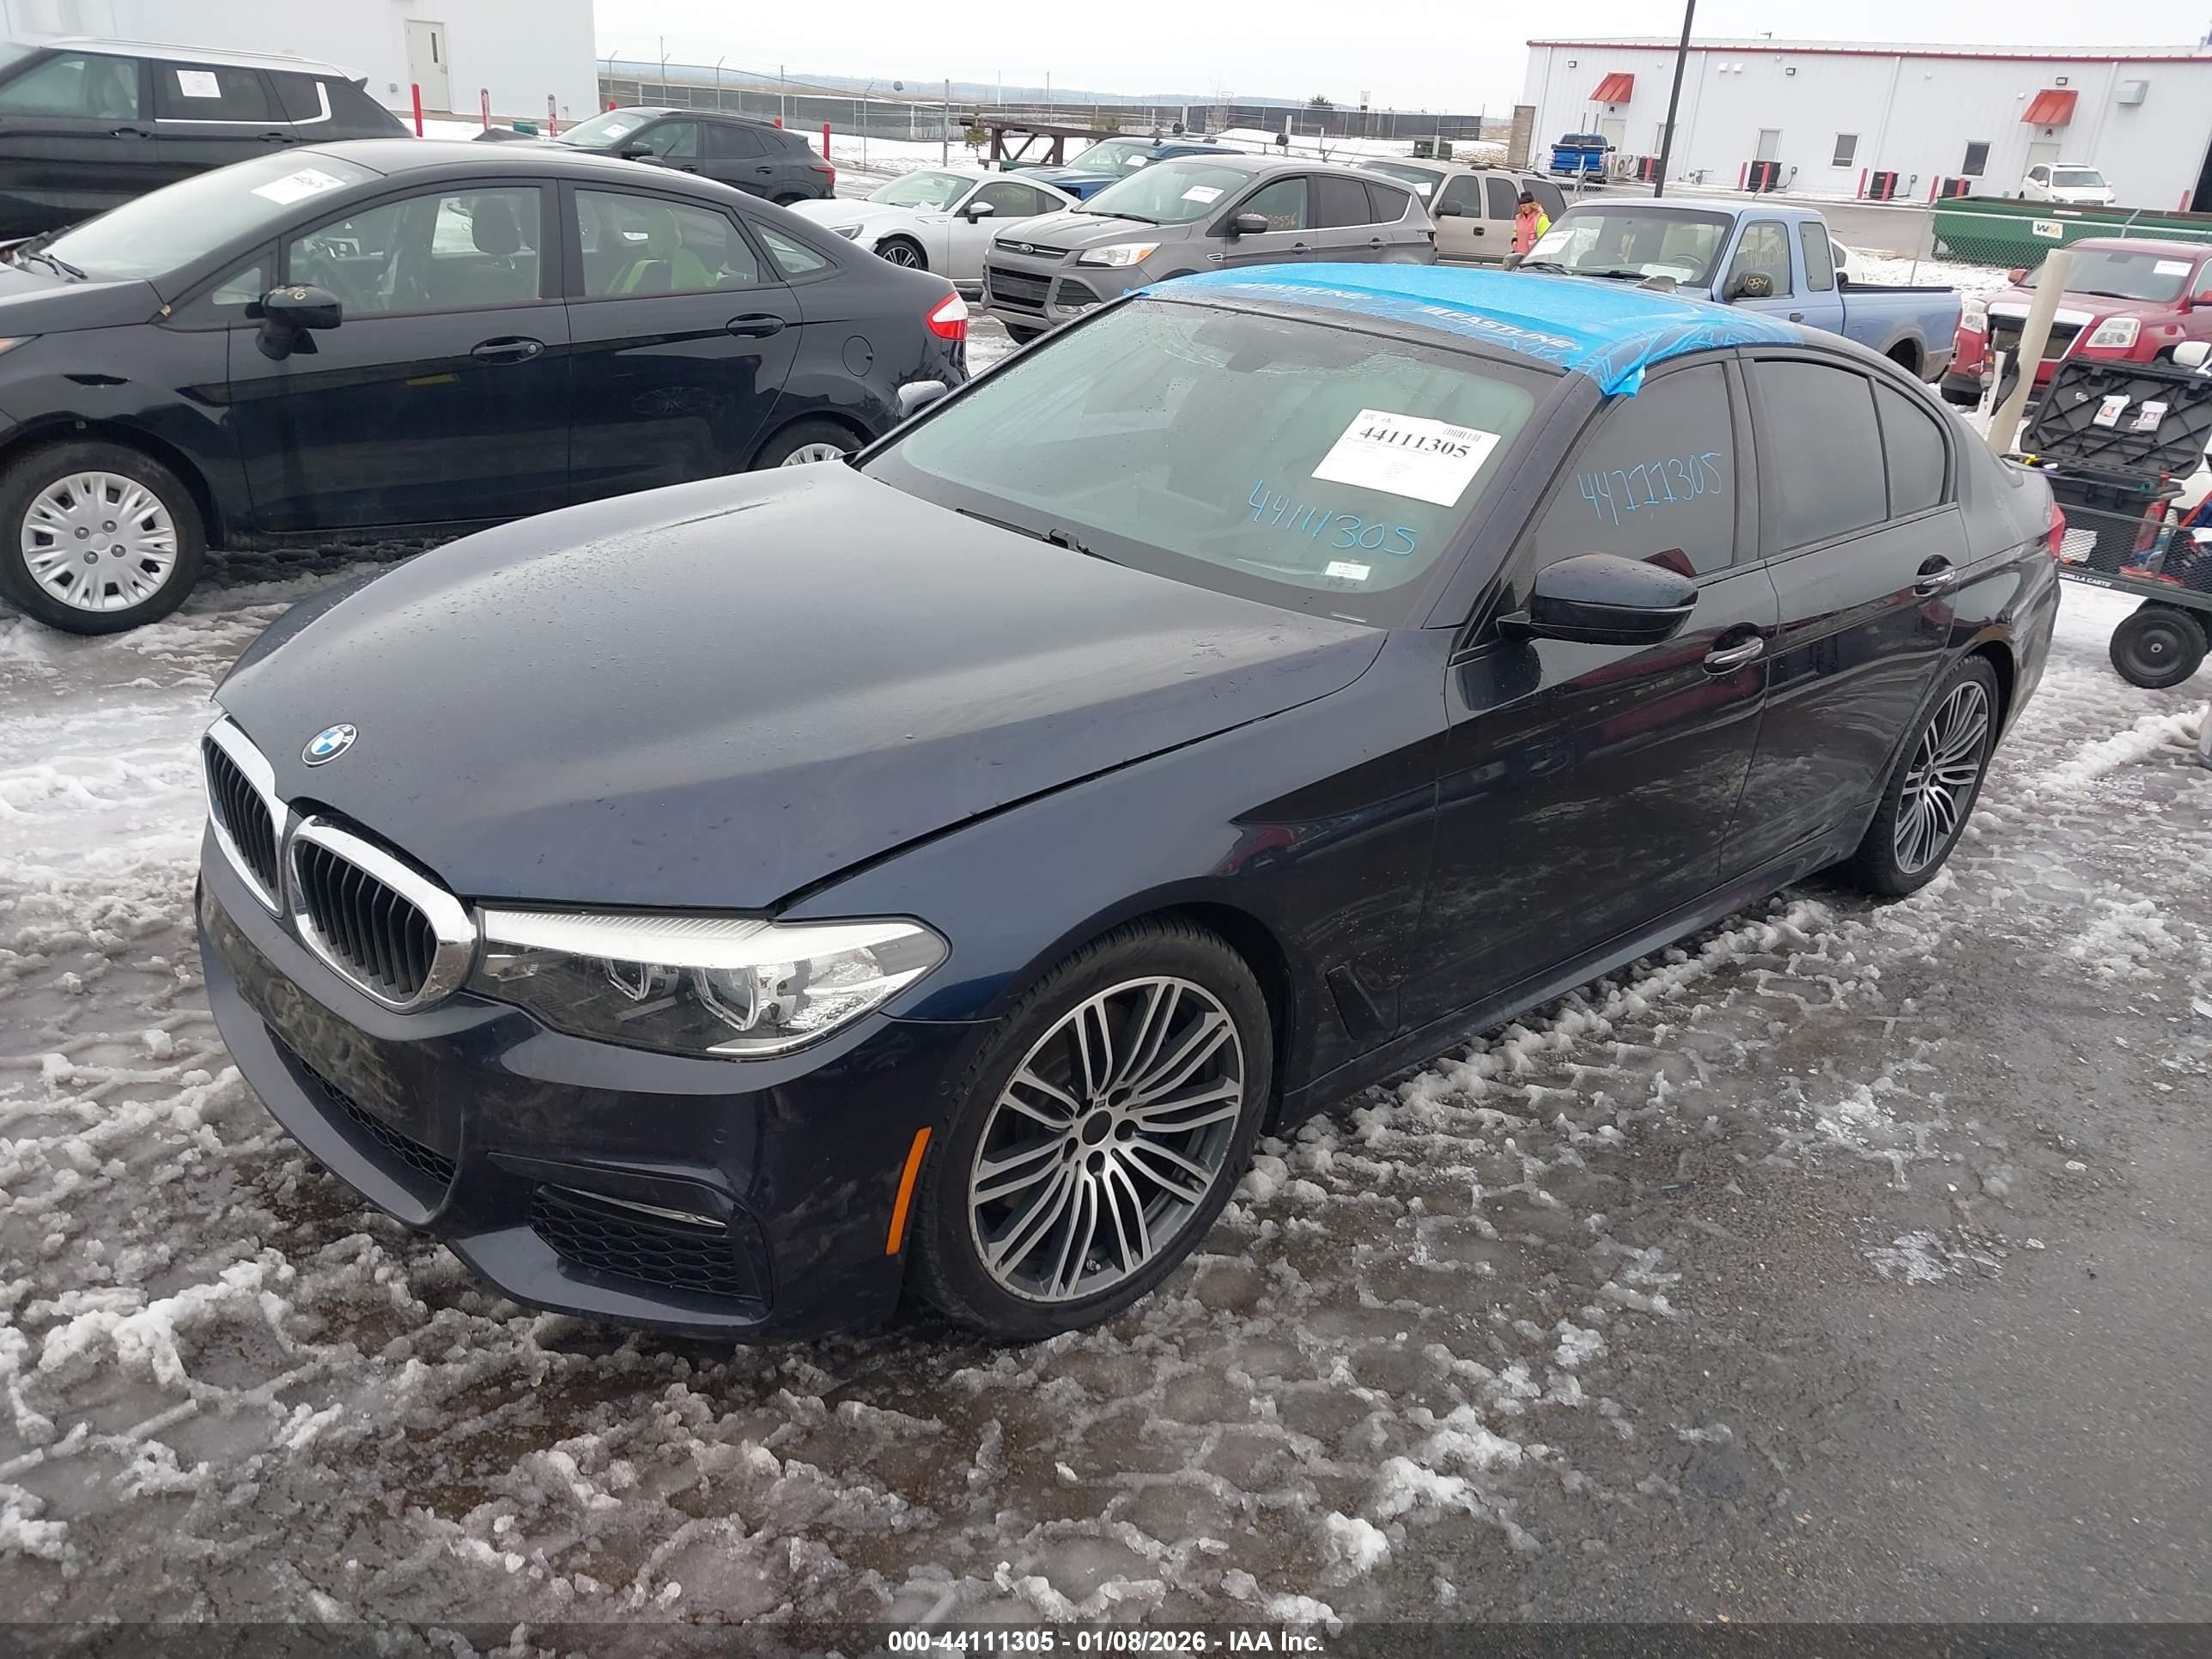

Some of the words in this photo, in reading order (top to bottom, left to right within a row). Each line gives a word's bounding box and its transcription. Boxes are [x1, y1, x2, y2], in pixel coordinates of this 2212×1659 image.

[2037, 223, 2059, 234] WM
[1744, 275, 1768, 289] 1084
[1443, 310, 1576, 349] FASTLINE
[1359, 426, 1473, 459] 44111305
[1577, 453, 1722, 526] 44111305
[1248, 480, 1417, 556] 44111305
[2086, 578, 2113, 587] CARTS
